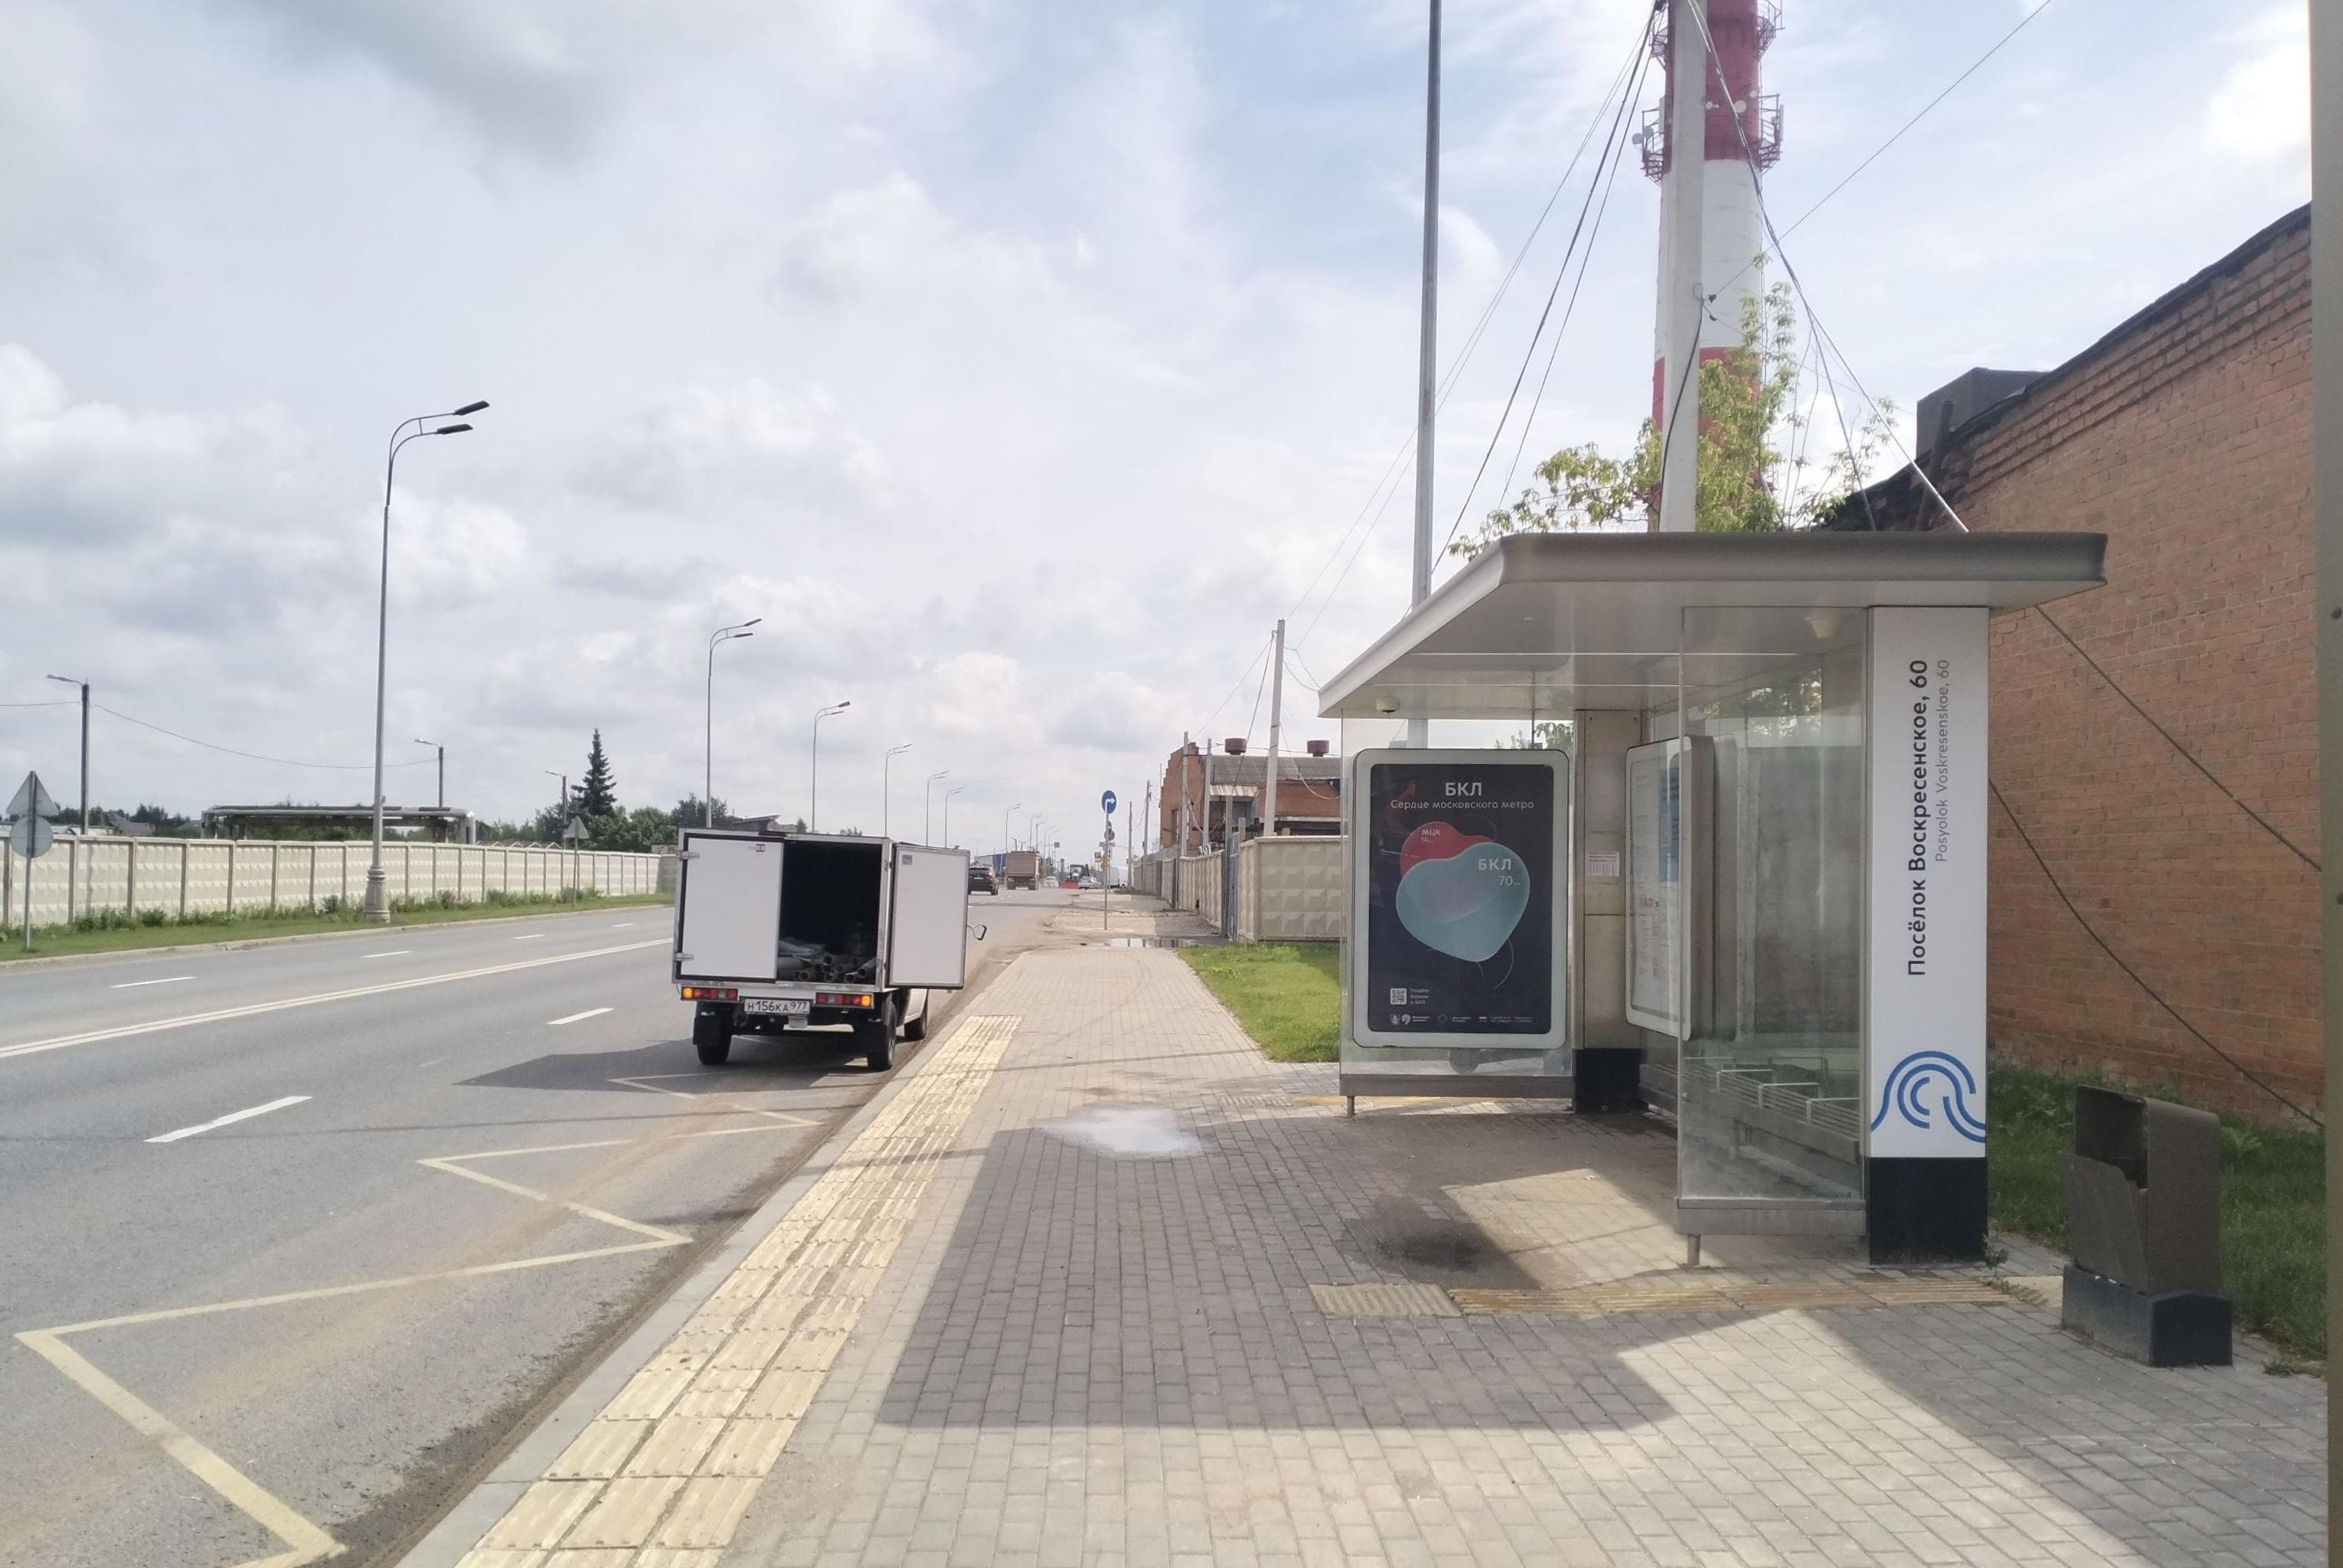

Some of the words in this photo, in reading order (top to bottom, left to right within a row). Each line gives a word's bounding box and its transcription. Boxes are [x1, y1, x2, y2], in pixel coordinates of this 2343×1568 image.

[1910, 660, 1927, 688] 60
[1937, 659, 1949, 678] 60
[1936, 683, 1950, 793] Voskresenskoe,
[1445, 782, 1482, 796] БКЛ
[1908, 695, 1931, 871] Воскресенское,
[1390, 799, 1430, 810] Сердце
[1433, 800, 1498, 811] московского
[1502, 801, 1534, 811] метро
[1936, 799, 1950, 862] Posyolok
[1478, 858, 1511, 871] БКЛ
[1498, 875, 1514, 886] 70
[1908, 879, 1926, 975] Посёлок
[790, 1001, 807, 1010] 977
